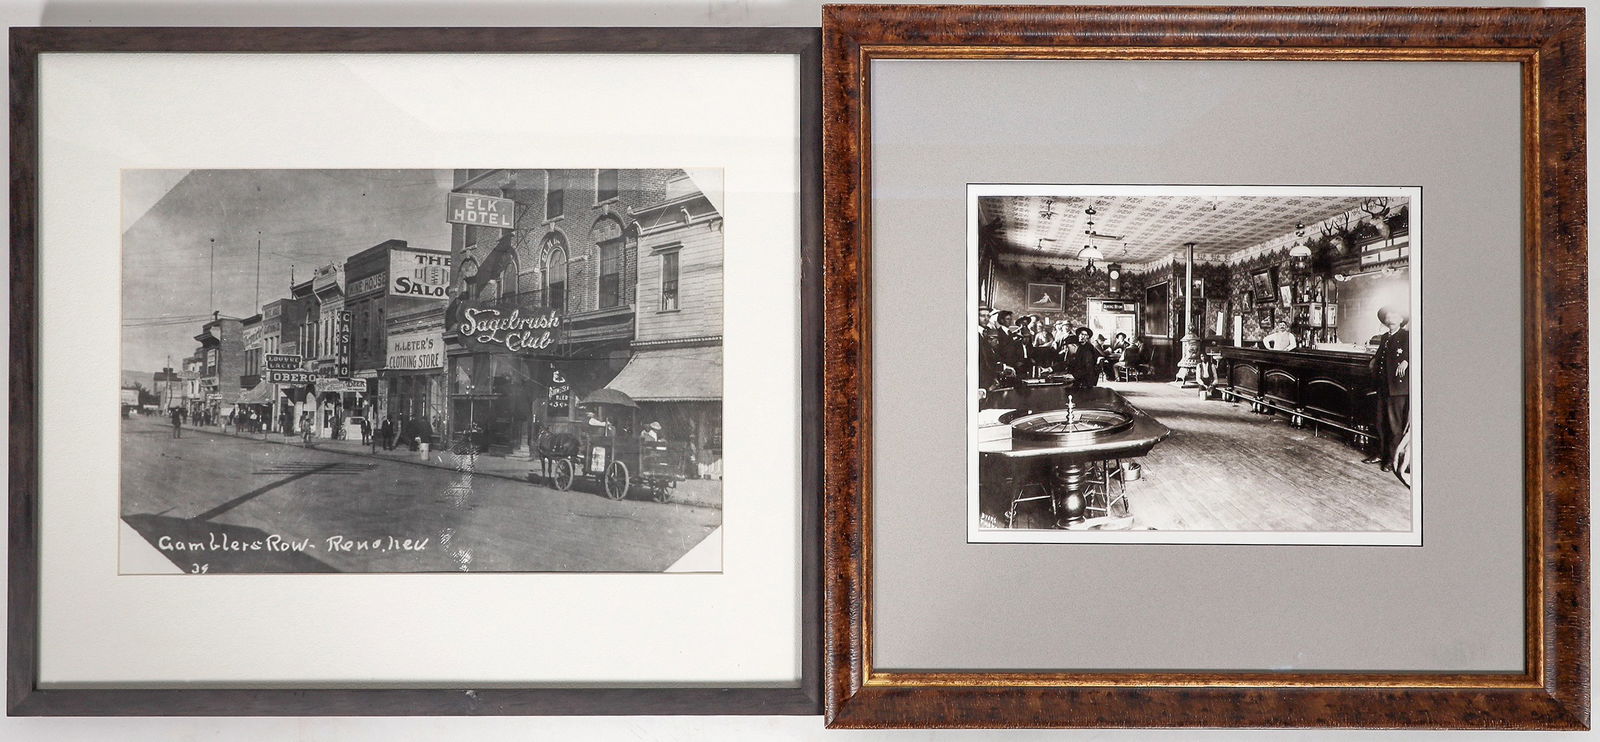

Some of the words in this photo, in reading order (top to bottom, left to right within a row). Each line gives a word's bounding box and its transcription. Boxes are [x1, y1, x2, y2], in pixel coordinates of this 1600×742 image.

[465, 198, 498, 212] ELK
[454, 209, 511, 226] HOTEL
[414, 254, 451, 267] THE
[460, 307, 561, 343] Sagebrush
[341, 313, 350, 376] CASINO
[505, 331, 555, 352] Club
[389, 355, 417, 369] CLOTHING
[418, 353, 439, 368] STORE
